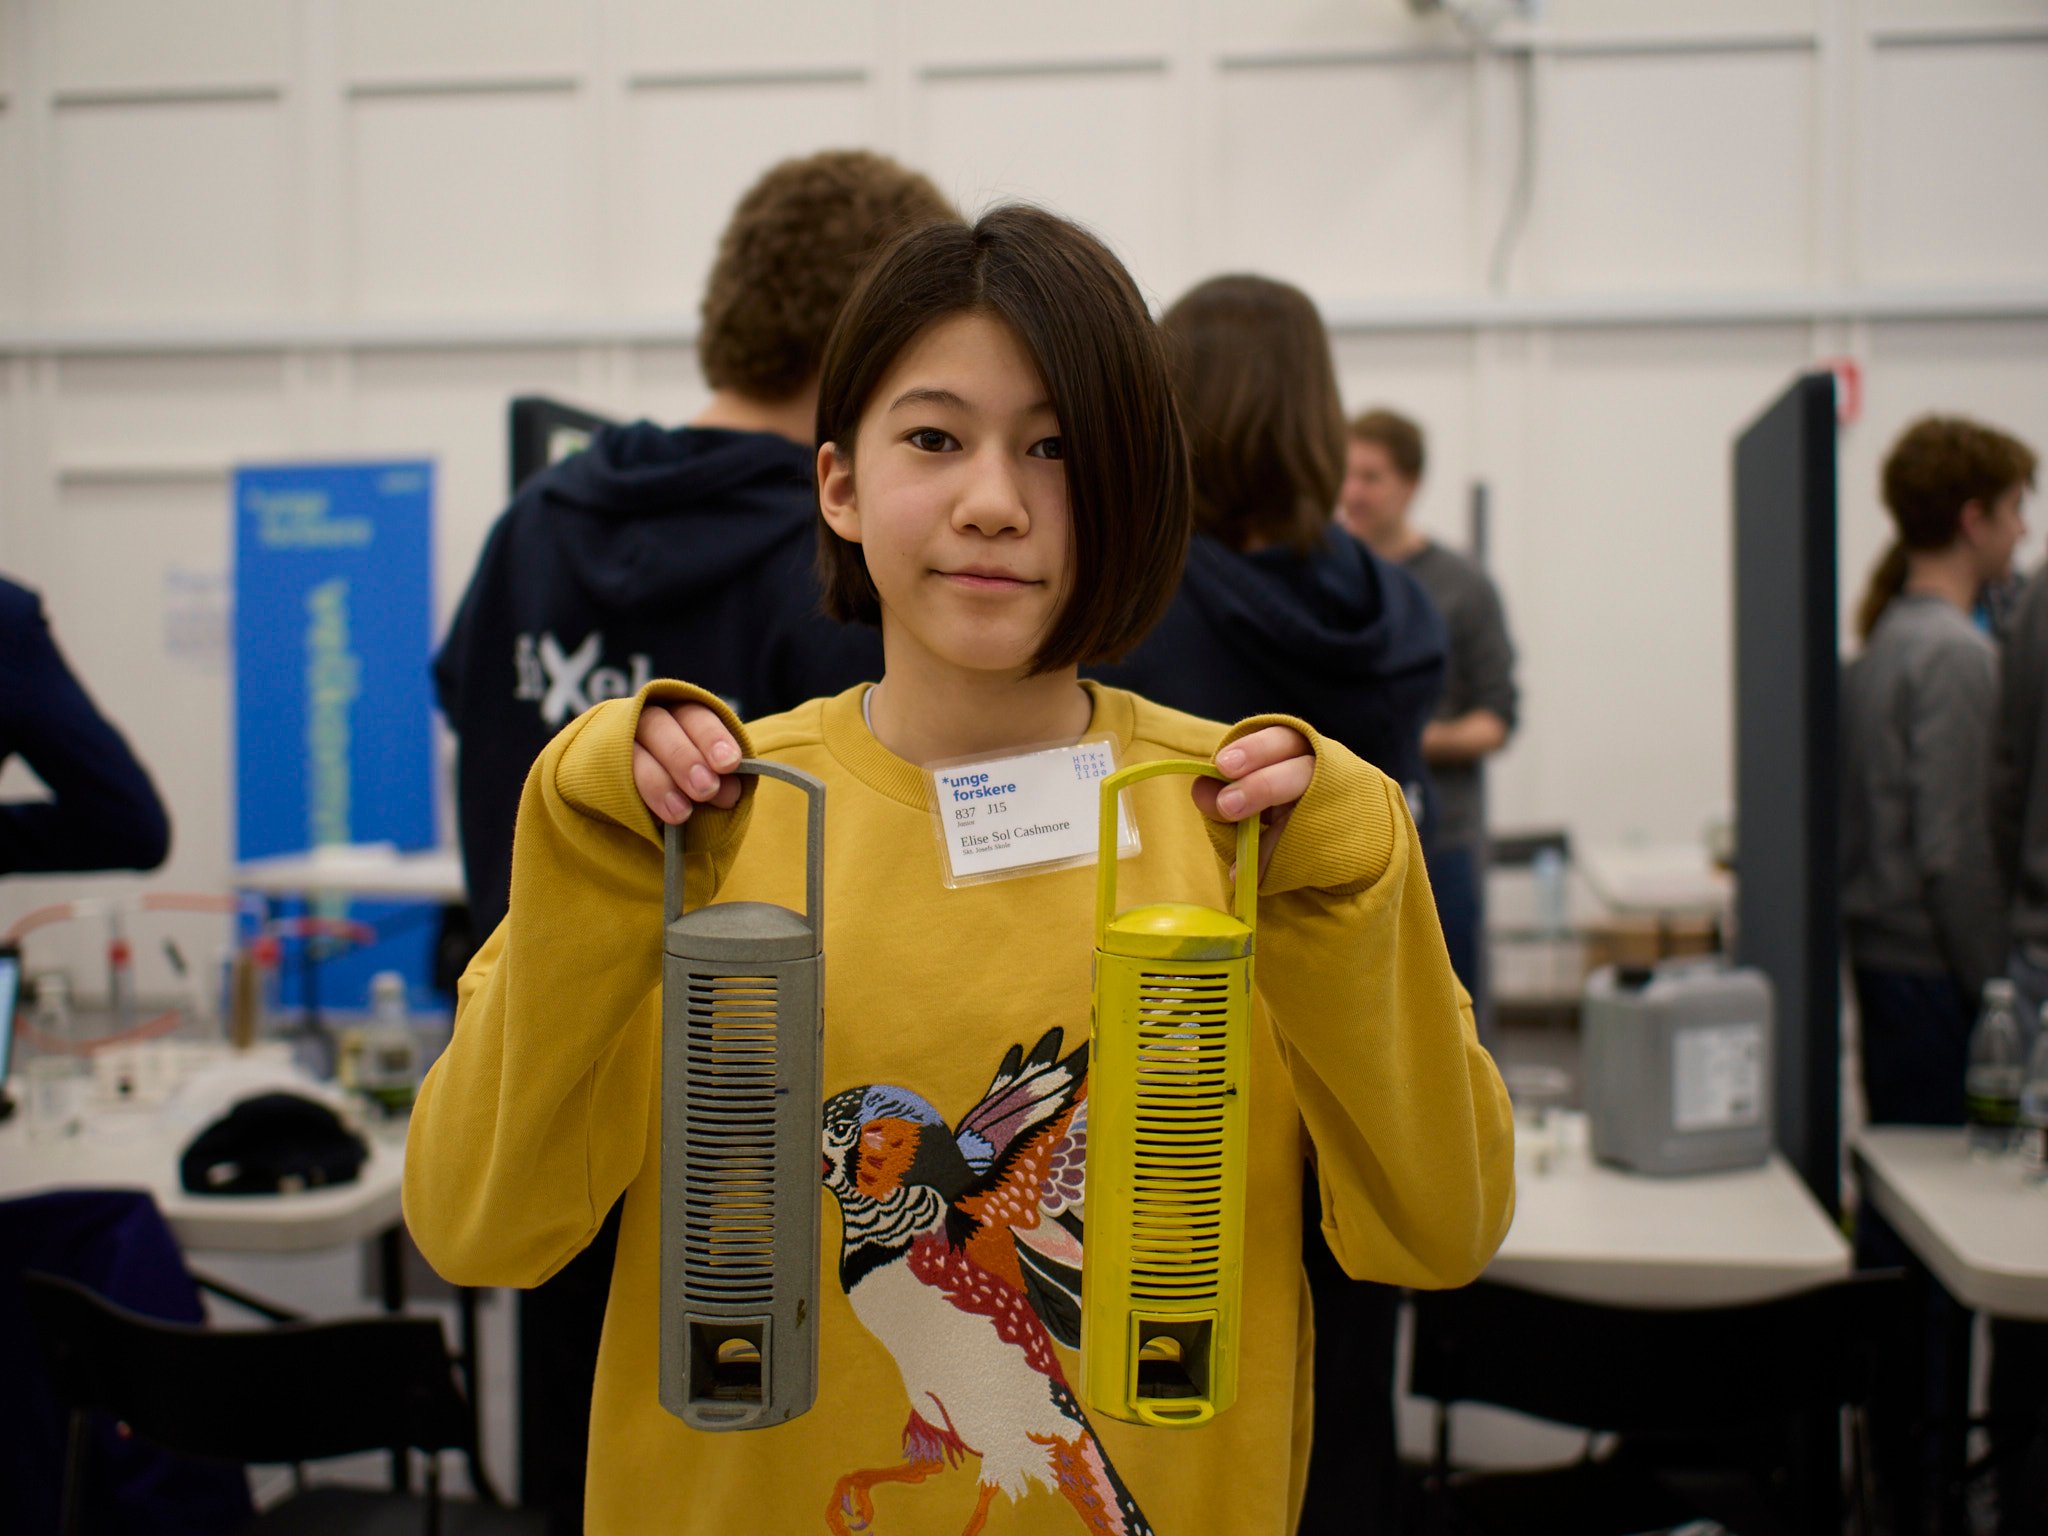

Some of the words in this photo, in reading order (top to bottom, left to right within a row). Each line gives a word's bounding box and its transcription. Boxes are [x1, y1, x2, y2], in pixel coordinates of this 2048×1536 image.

[953, 783, 1017, 802] forskere
[955, 807, 976, 820] 837
[987, 802, 1007, 815] J15
[961, 835, 989, 848] Elise
[992, 829, 1011, 842] Sol
[1013, 821, 1070, 839] Cashmore
